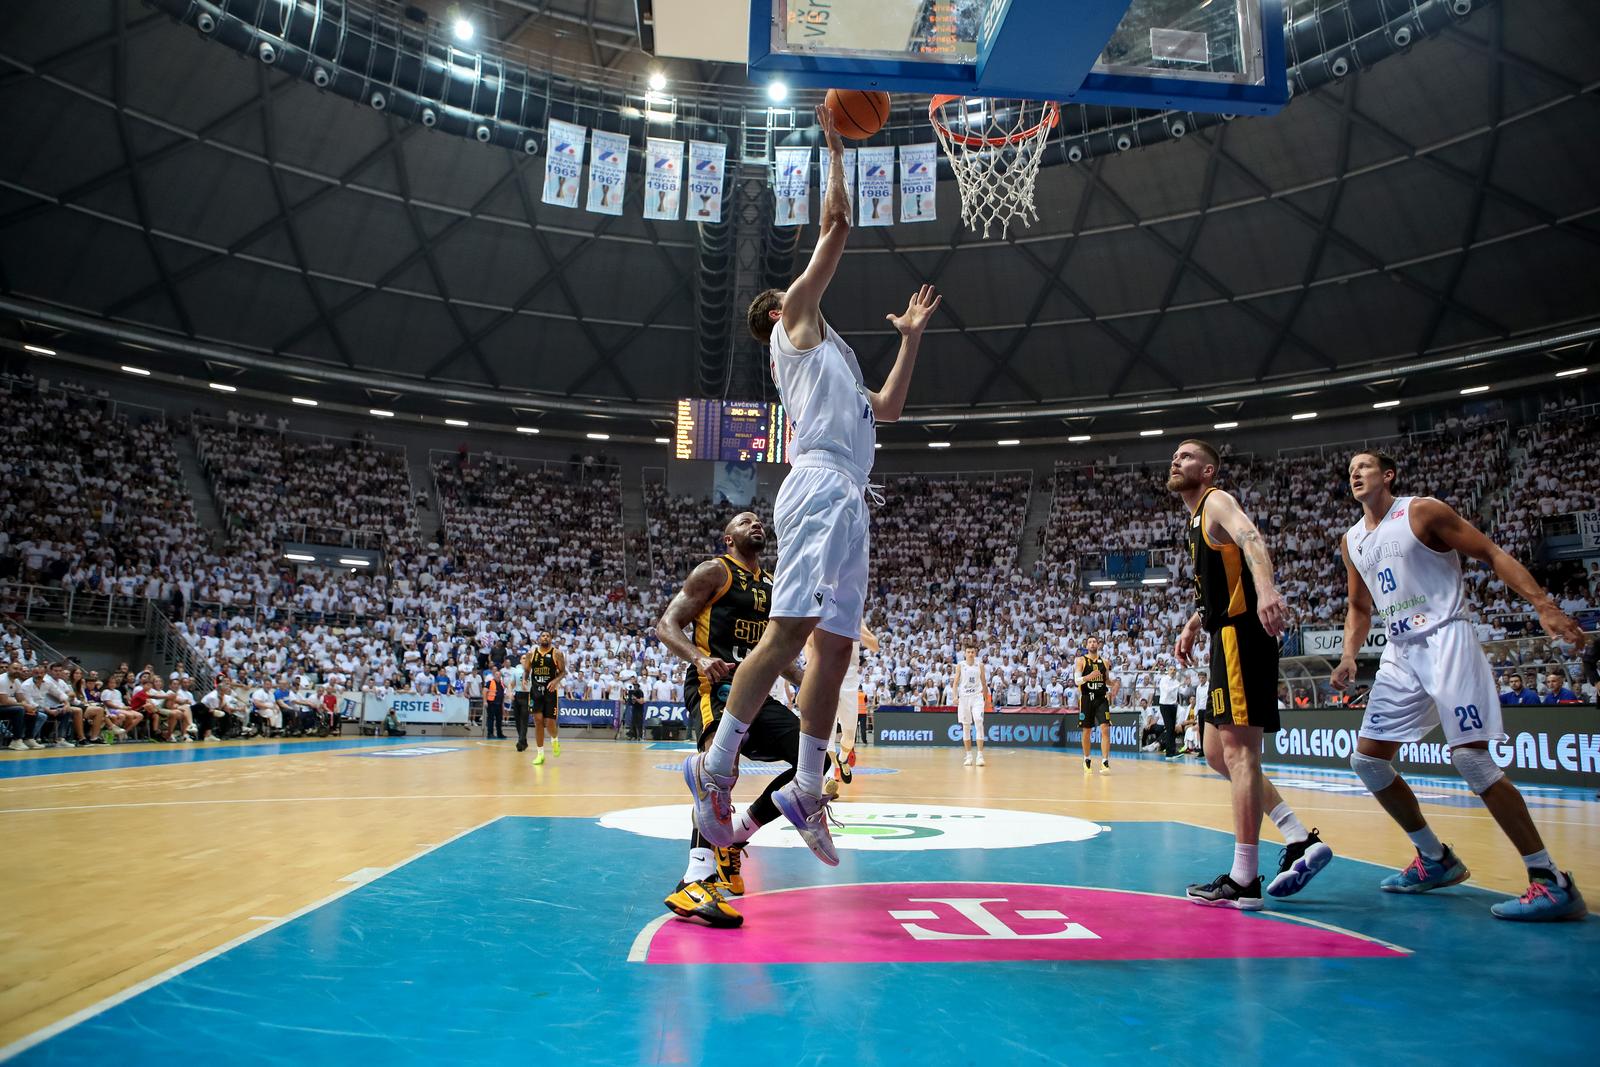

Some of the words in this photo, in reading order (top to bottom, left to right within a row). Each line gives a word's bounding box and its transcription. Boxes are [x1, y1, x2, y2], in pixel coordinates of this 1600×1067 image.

[752, 438, 766, 449] 20
[1377, 567, 1397, 594] 29
[751, 587, 767, 612] 12
[1390, 616, 1411, 636] SK
[1314, 633, 1388, 650] SUPNO
[393, 700, 430, 712] ERSTE
[560, 707, 588, 717] SVOJU
[590, 708, 614, 717] IGRU.
[644, 705, 687, 721] PSK
[1454, 703, 1483, 732] 29
[880, 729, 934, 742] PARKETI
[947, 720, 1060, 743] GEKOVIĆ
[1090, 720, 1137, 745] GAKOVIĆ
[1275, 727, 1362, 759] GALEKOV
[1399, 742, 1451, 765] PARKE
